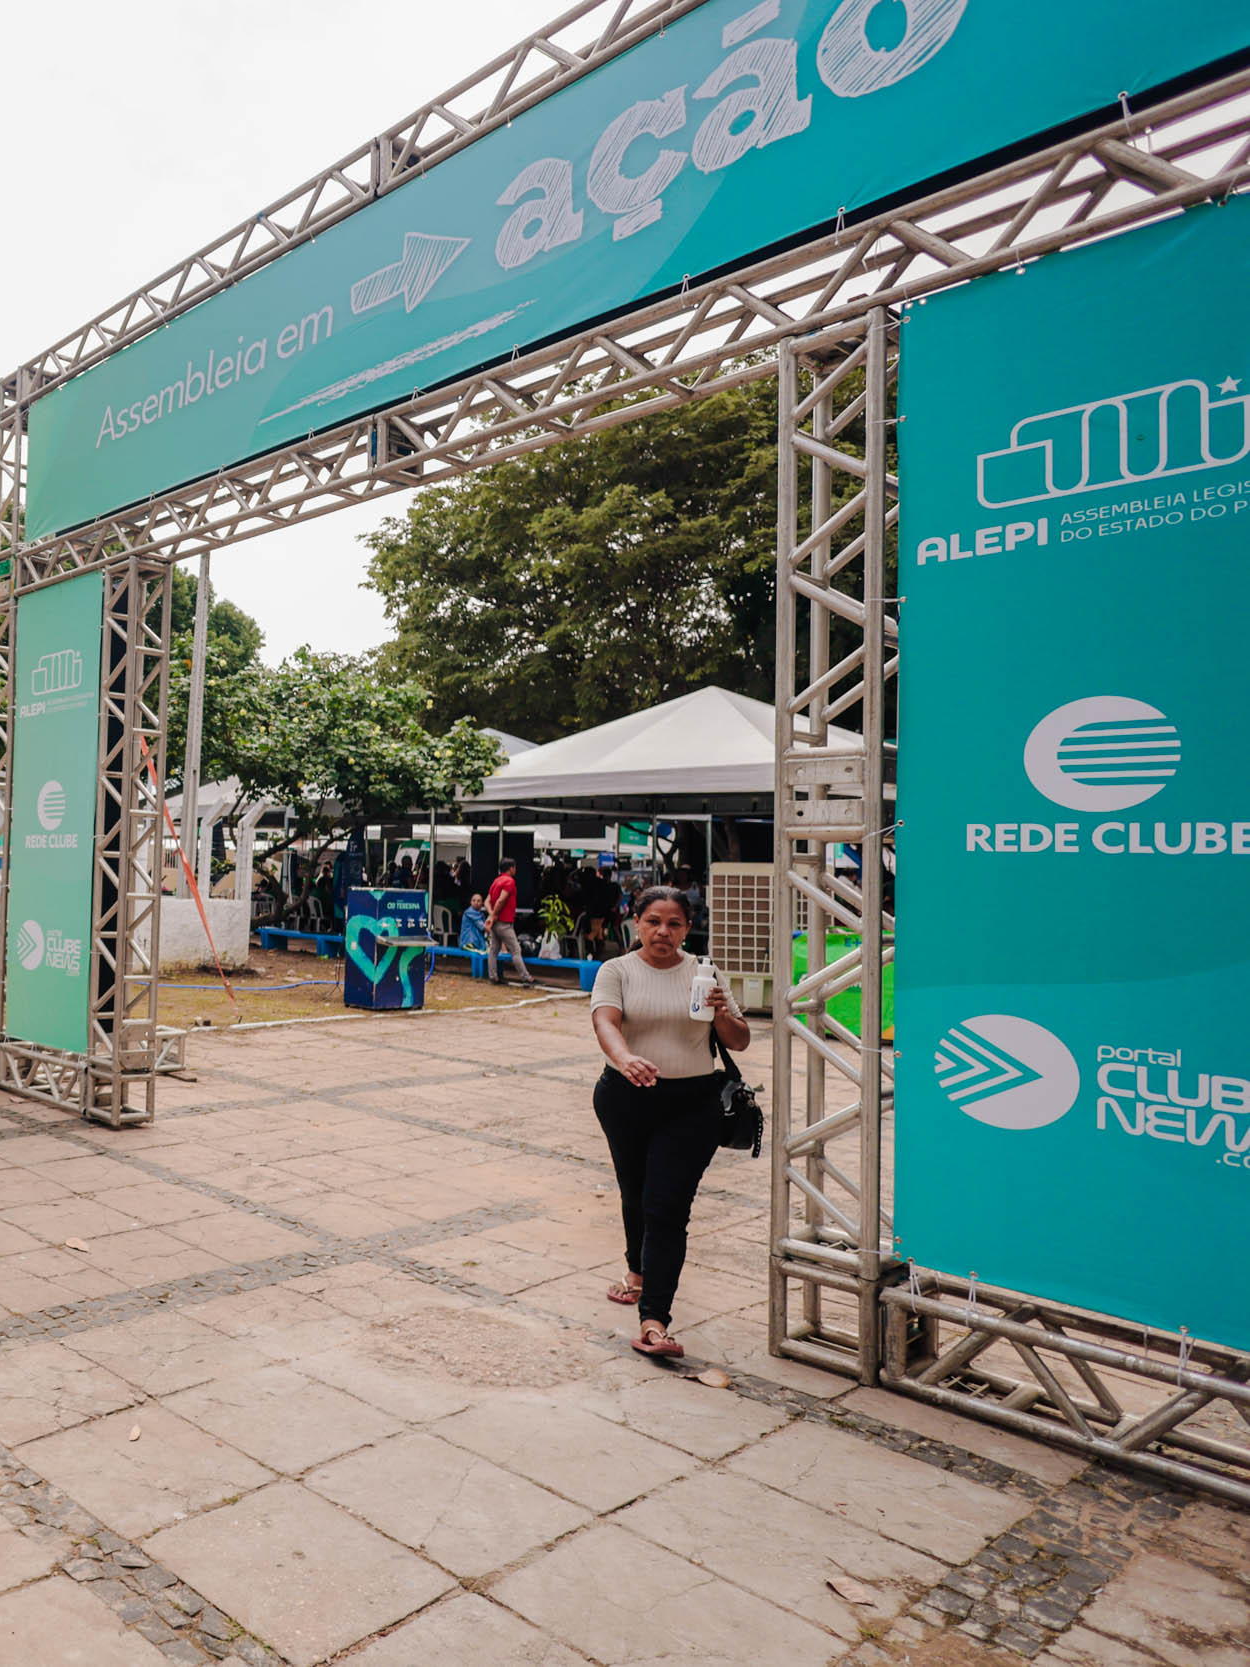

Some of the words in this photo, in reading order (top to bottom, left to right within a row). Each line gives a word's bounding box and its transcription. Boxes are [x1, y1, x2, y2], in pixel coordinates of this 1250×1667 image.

[95, 335, 268, 449] Assembleia
[276, 304, 334, 359] em
[494, 0, 969, 271] ação
[1060, 491, 1187, 526] ASSEMBLEIA
[1060, 526, 1092, 543] DO
[1098, 511, 1184, 537] ESTADO
[1190, 503, 1227, 521] DO
[916, 517, 1049, 566] ALEPI
[966, 822, 1080, 853] REDE
[1091, 821, 1250, 855] CLUBE
[1096, 1044, 1182, 1068] portal
